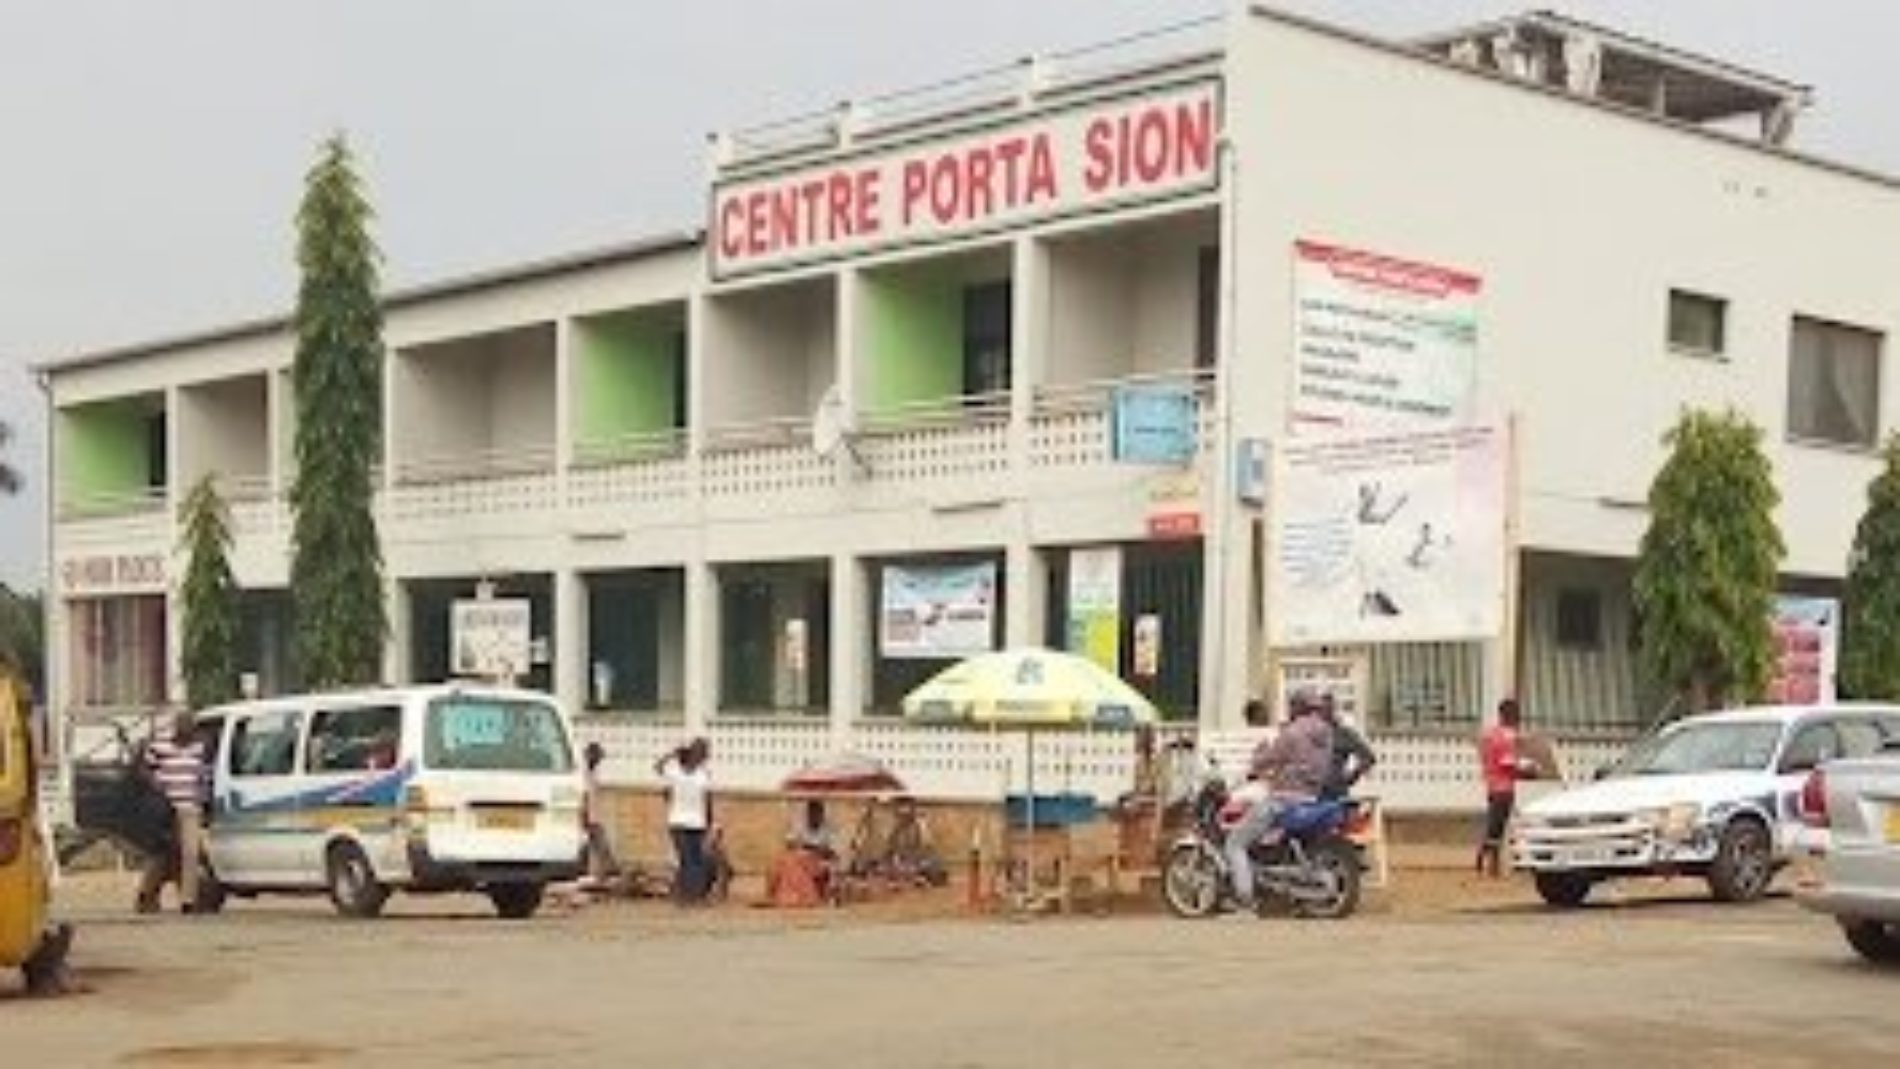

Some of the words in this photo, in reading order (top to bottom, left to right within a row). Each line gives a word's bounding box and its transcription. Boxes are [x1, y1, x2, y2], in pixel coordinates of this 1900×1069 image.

[720, 168, 879, 259] CENTRE
[903, 132, 1057, 225] PORTA
[1084, 99, 1211, 193] SION
